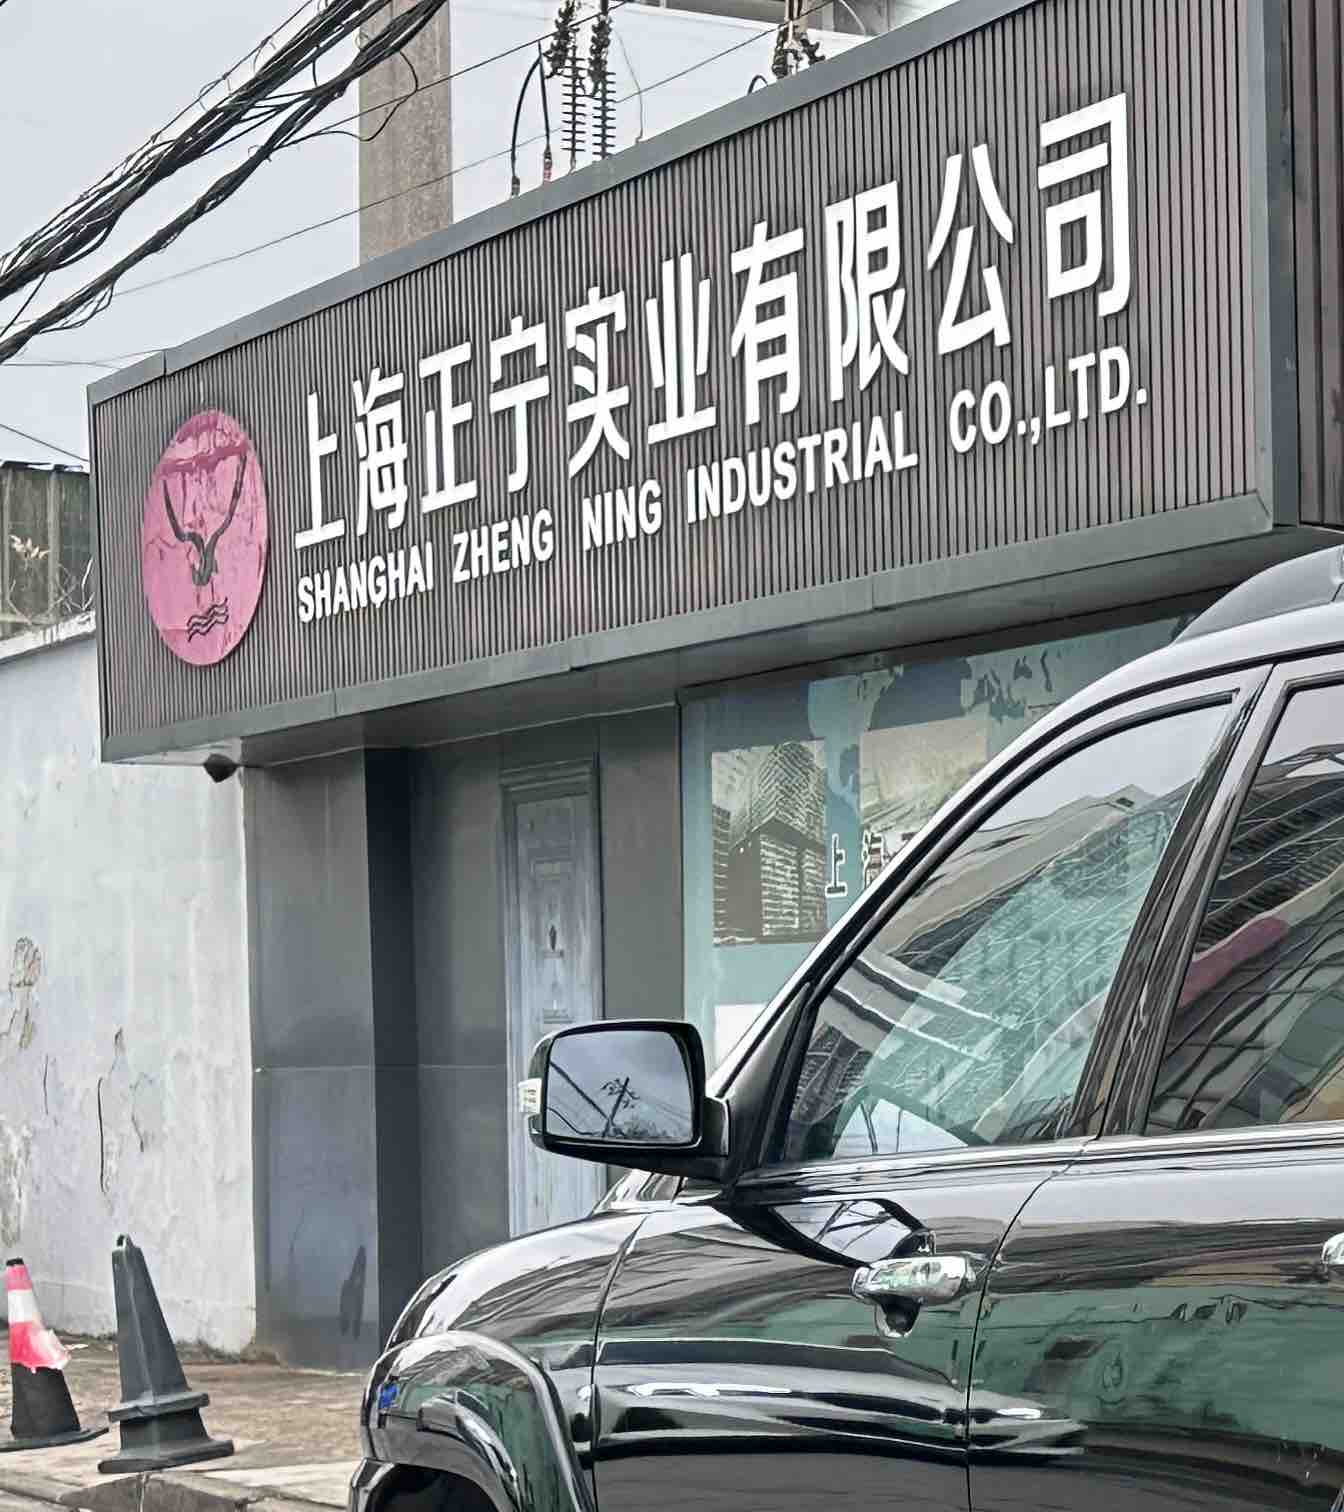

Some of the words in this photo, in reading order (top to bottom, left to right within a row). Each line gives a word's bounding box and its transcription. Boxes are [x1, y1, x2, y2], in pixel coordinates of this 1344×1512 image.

[295, 92, 1131, 550] 上海正宁实业有限公司
[298, 541, 434, 623] SHANGHAI
[453, 508, 555, 584] ZHENG
[582, 479, 663, 551] NING
[687, 410, 919, 523] INDUSTRIAL
[949, 345, 1147, 454] CO.,LTD.
